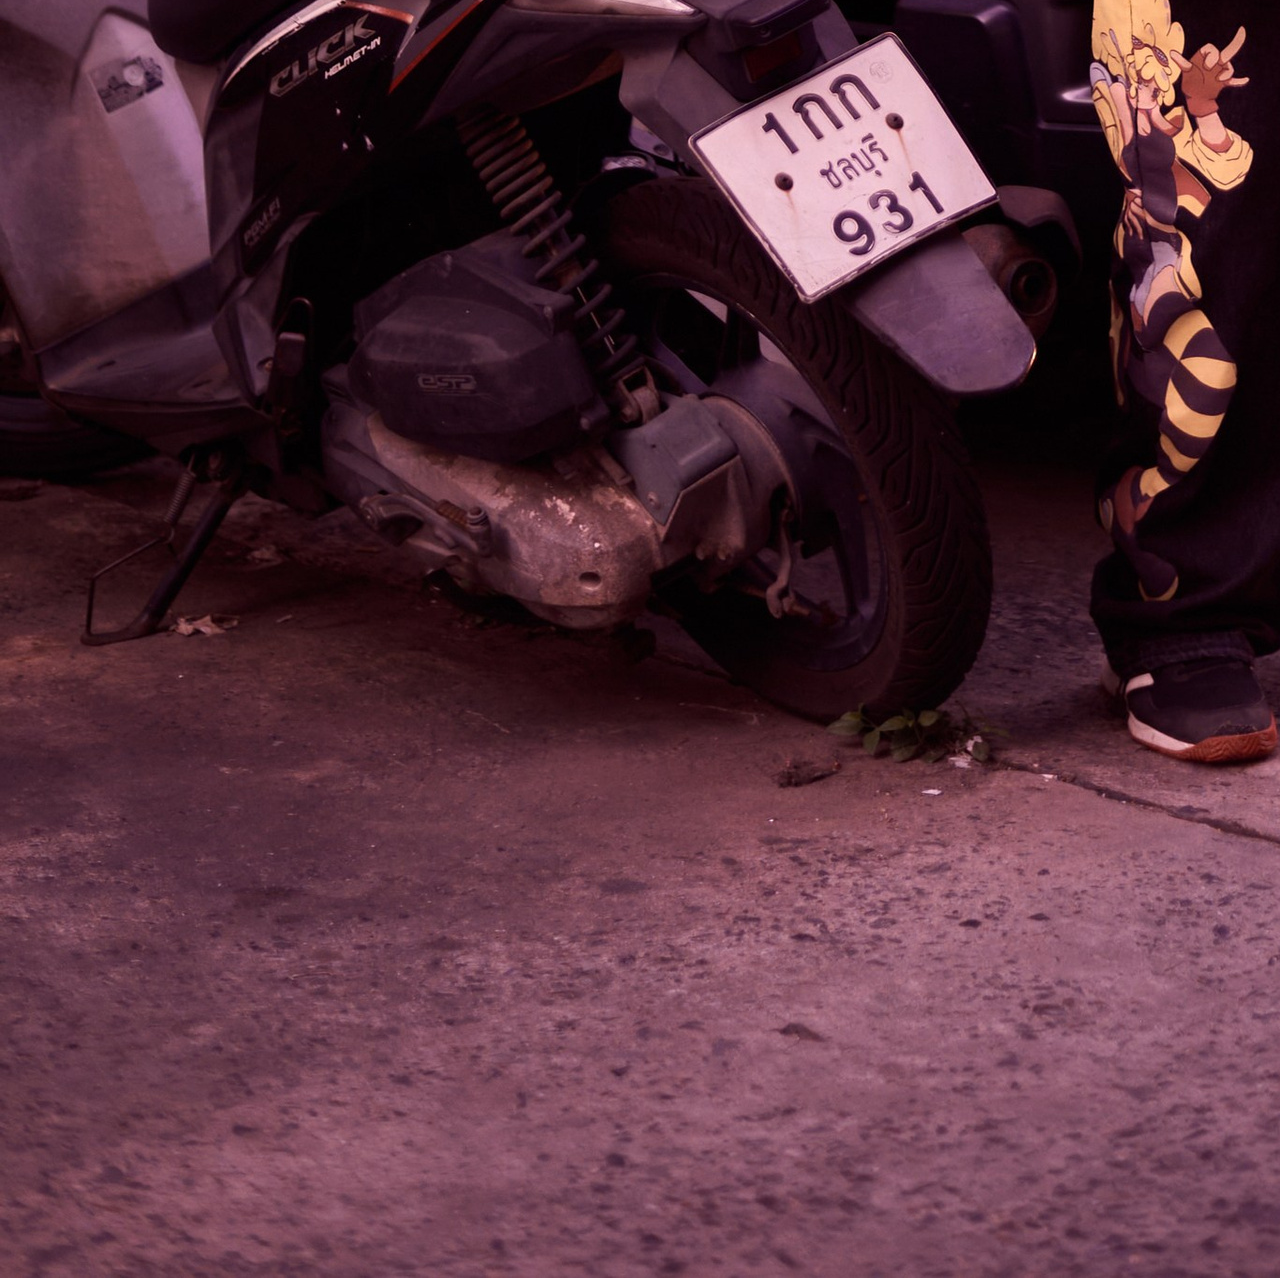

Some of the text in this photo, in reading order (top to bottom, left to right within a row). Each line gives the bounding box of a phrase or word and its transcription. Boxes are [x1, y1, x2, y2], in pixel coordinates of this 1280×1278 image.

[269, 13, 376, 97] CLICK
[324, 36, 382, 80] HELMET-IN
[761, 73, 881, 154] 1กก
[818, 131, 890, 190] ชลบุรี
[832, 169, 945, 256] 931
